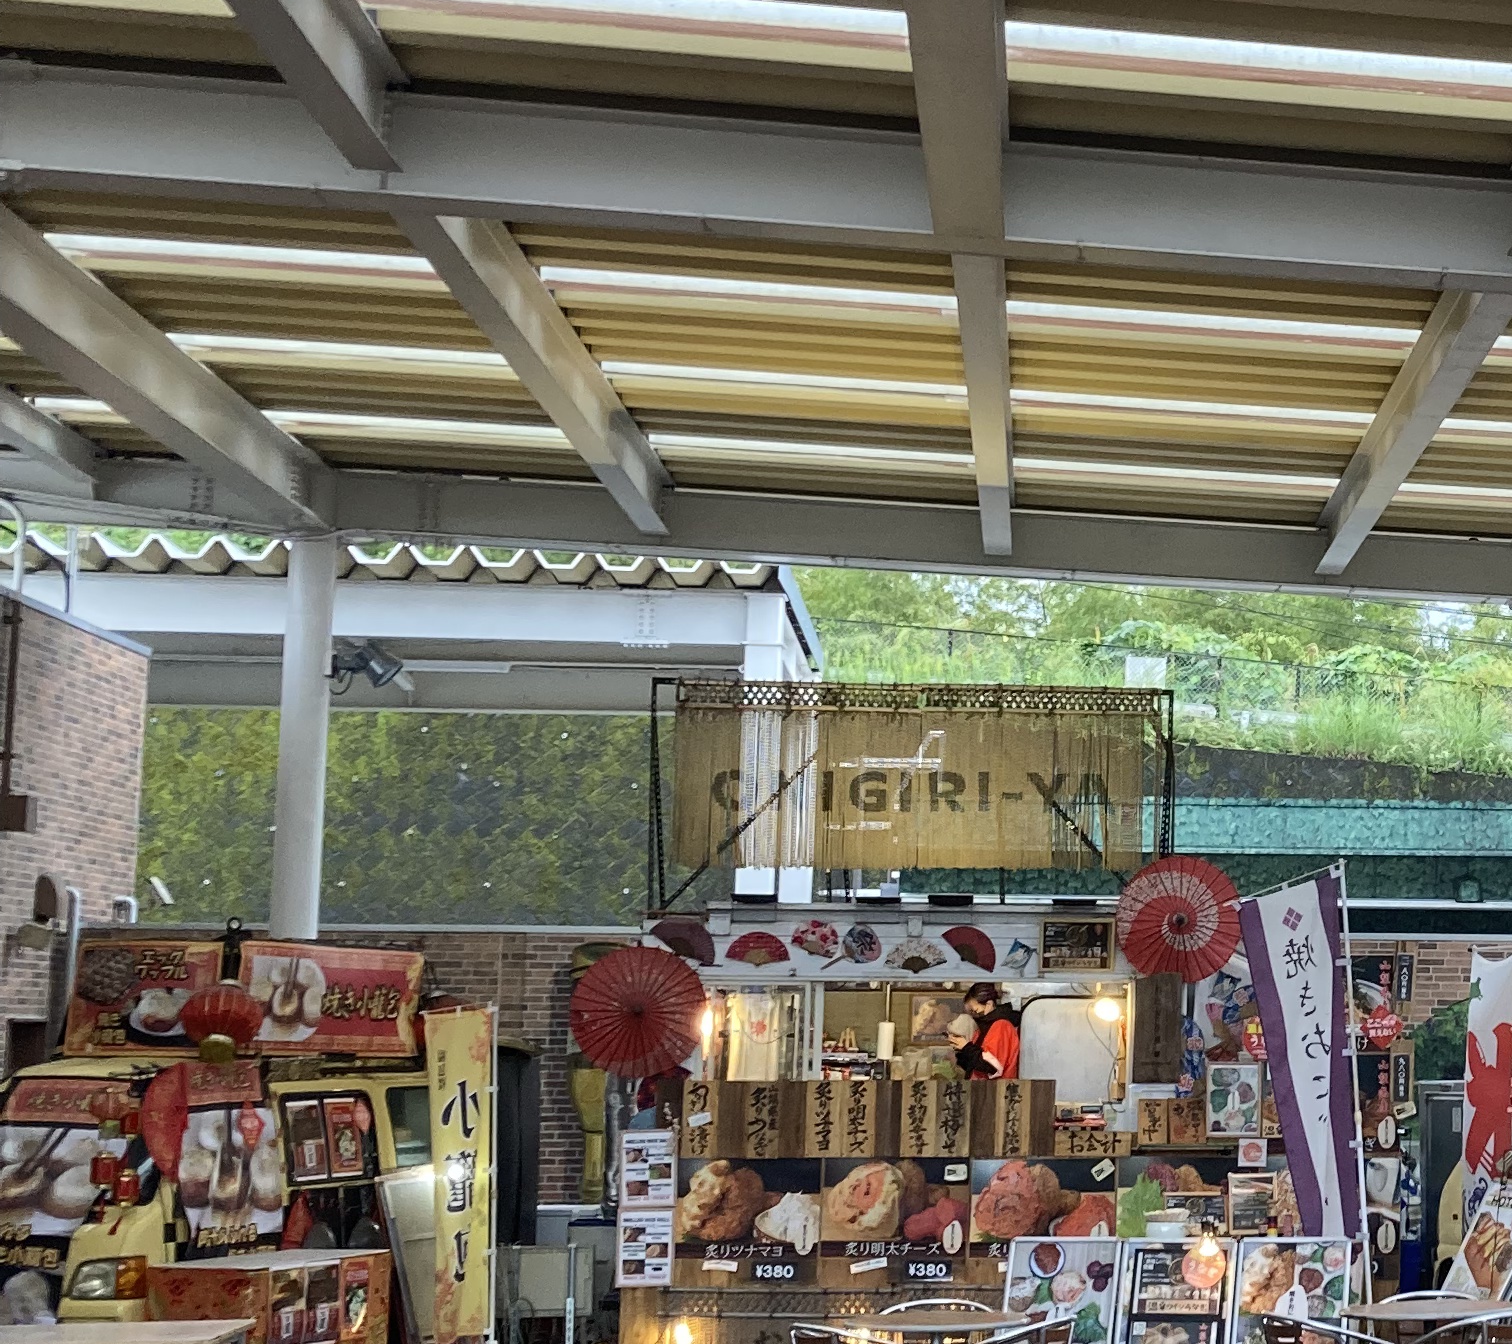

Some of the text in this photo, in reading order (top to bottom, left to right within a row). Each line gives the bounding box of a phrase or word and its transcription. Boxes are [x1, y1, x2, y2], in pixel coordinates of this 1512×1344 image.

[813, 1081, 834, 1152] 炙りツナマヨ
[1067, 1132, 1122, 1155] お会計
[704, 1242, 784, 1259] 炙りツナマヨ
[844, 1240, 942, 1258] 炙り明太チーズ
[755, 1263, 795, 1279] ¥380
[907, 1261, 947, 1278] ¥380
